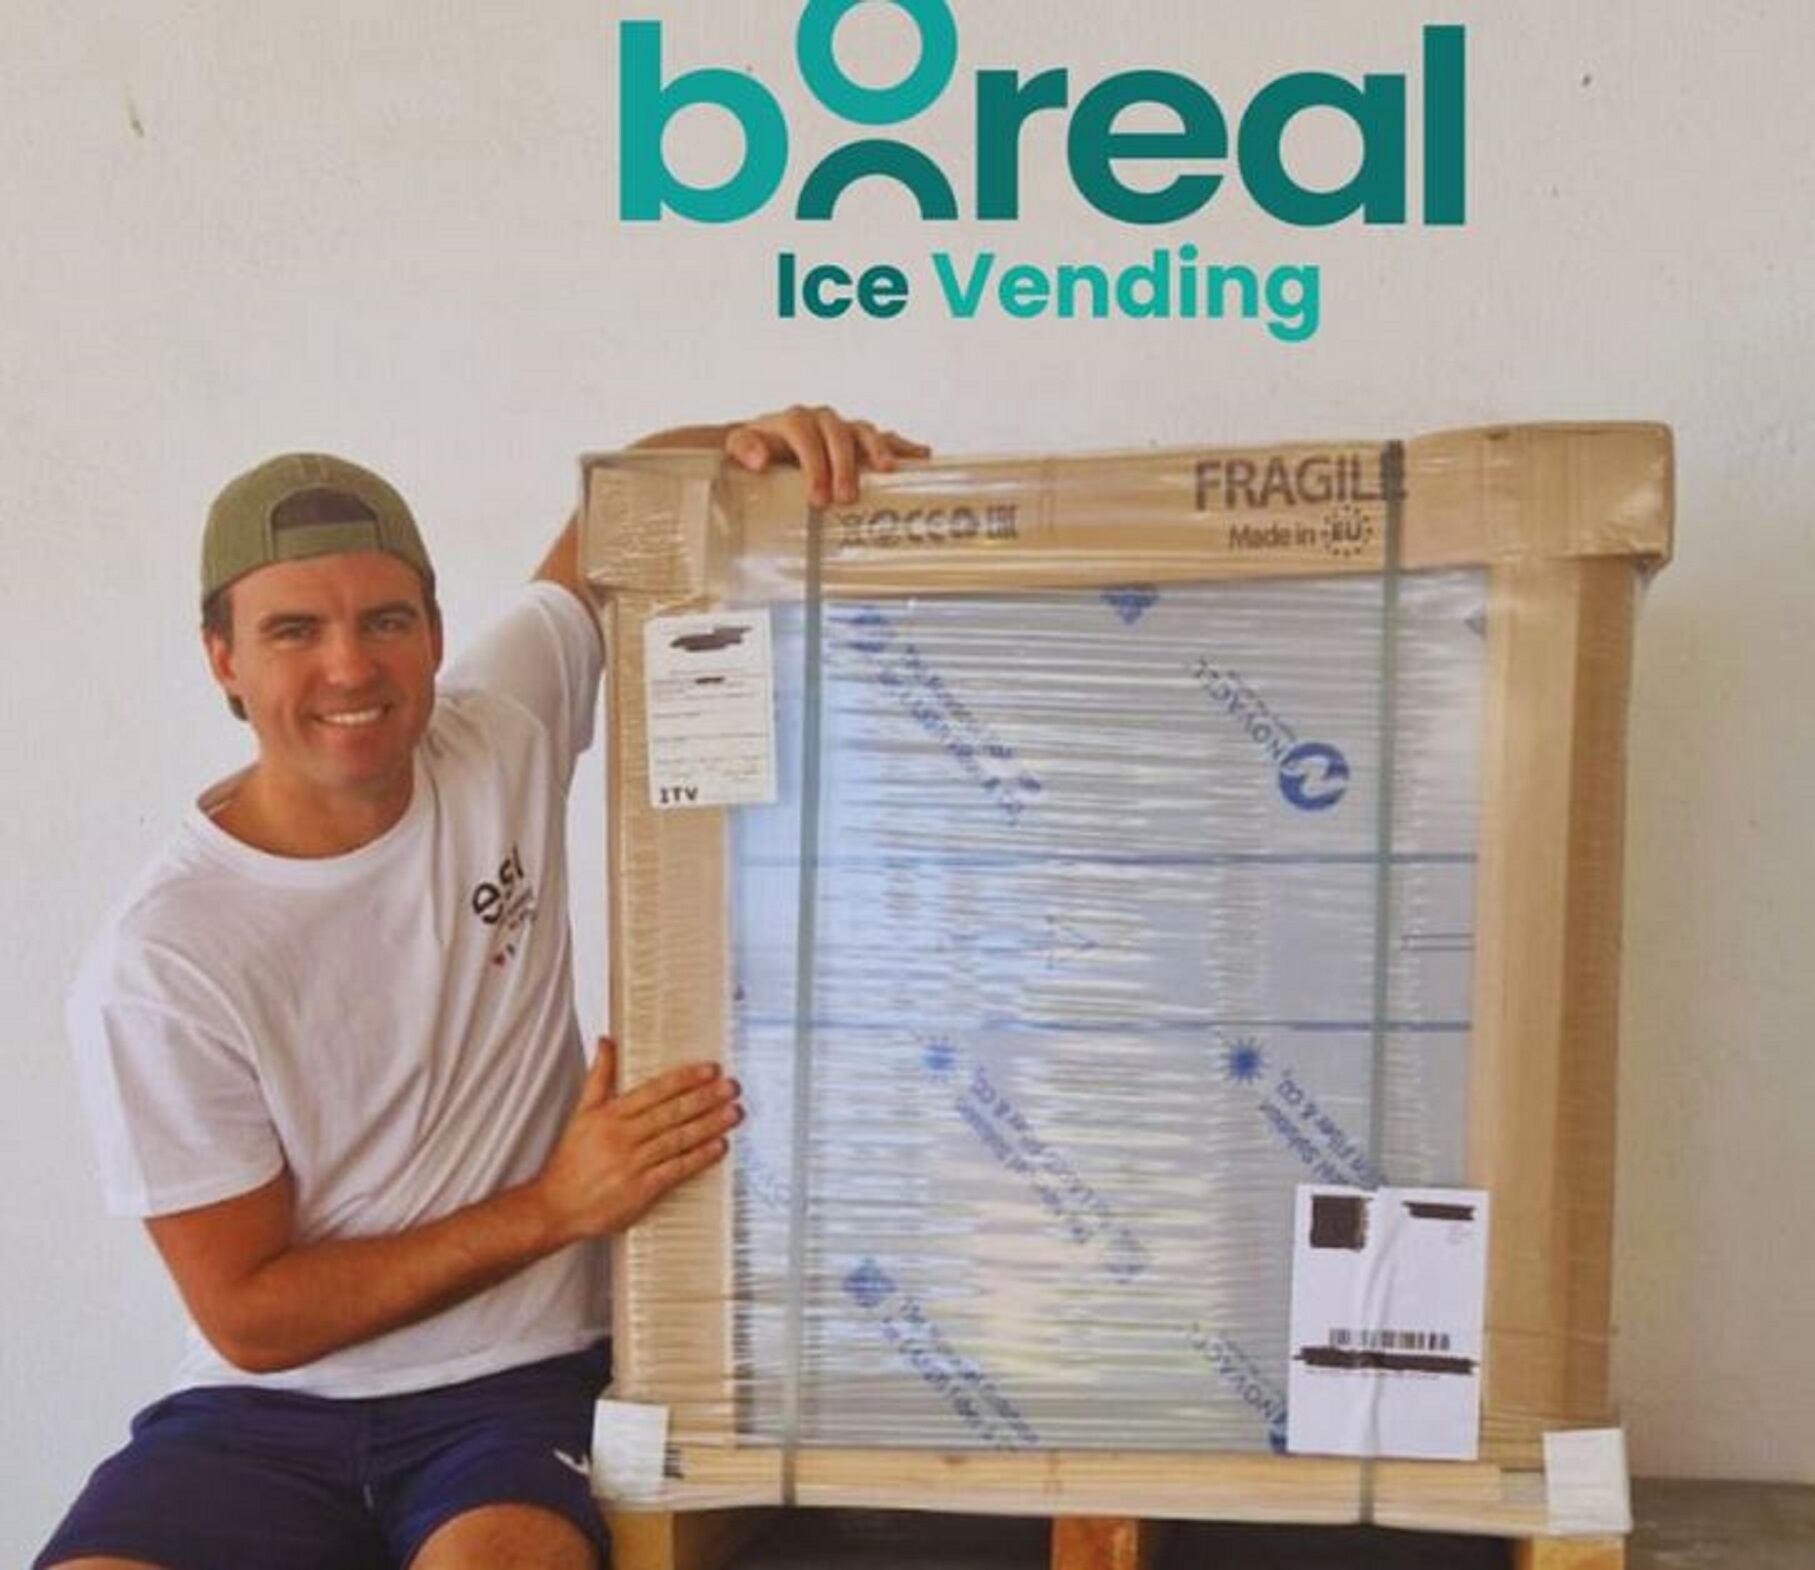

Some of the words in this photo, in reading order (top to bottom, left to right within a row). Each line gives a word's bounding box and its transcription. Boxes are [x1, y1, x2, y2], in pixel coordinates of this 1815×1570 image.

[1228, 524, 1291, 549] Made
[1295, 521, 1316, 545] in
[1331, 519, 1362, 542] EU
[659, 786, 699, 804] ITV
